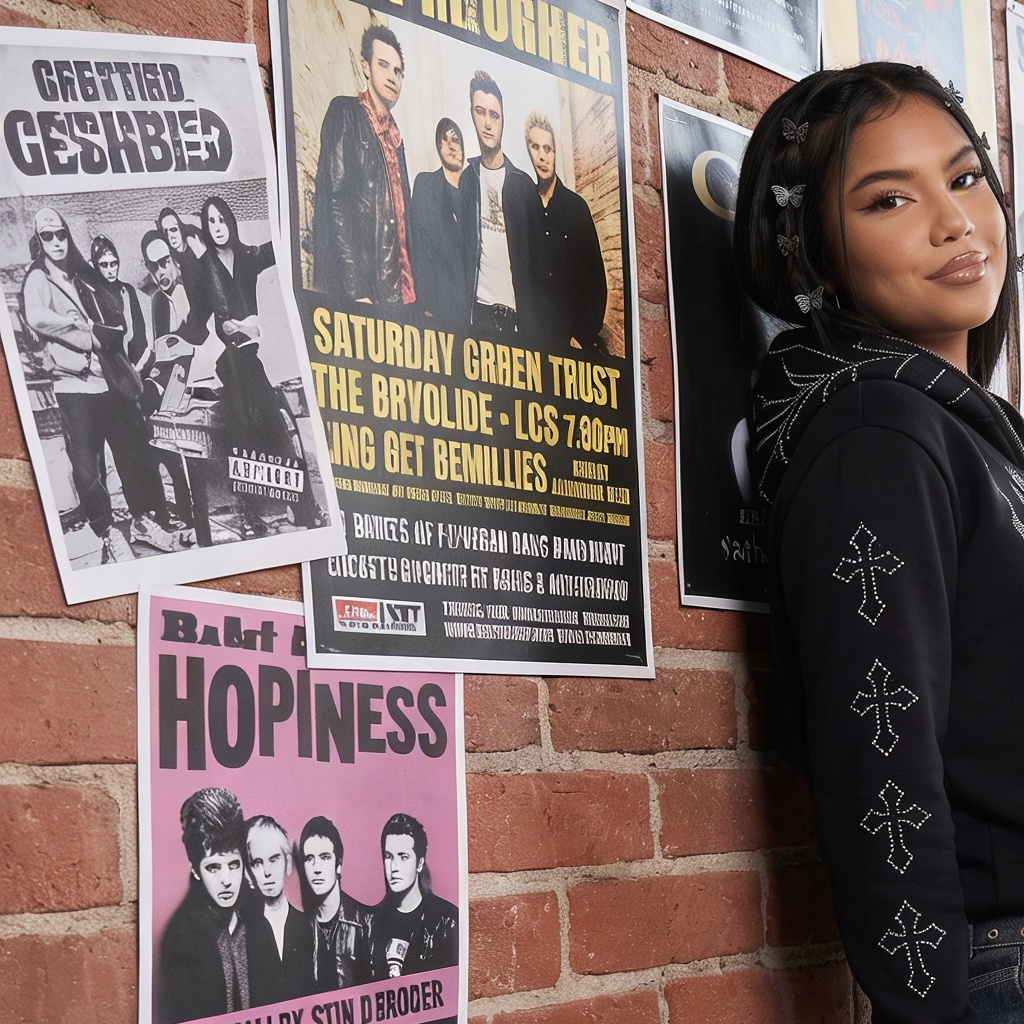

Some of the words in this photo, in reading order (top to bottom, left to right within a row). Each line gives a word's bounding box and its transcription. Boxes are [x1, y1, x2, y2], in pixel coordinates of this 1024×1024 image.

[311, 361, 364, 414] THE
[514, 400, 560, 446] LCS
[313, 307, 454, 376] SATURDAY
[548, 355, 621, 409] TRUST
[327, 421, 379, 471] ING
[384, 430, 425, 477] GET
[433, 437, 548, 493] BEMILLIES
[158, 653, 447, 771] HOPINESS
